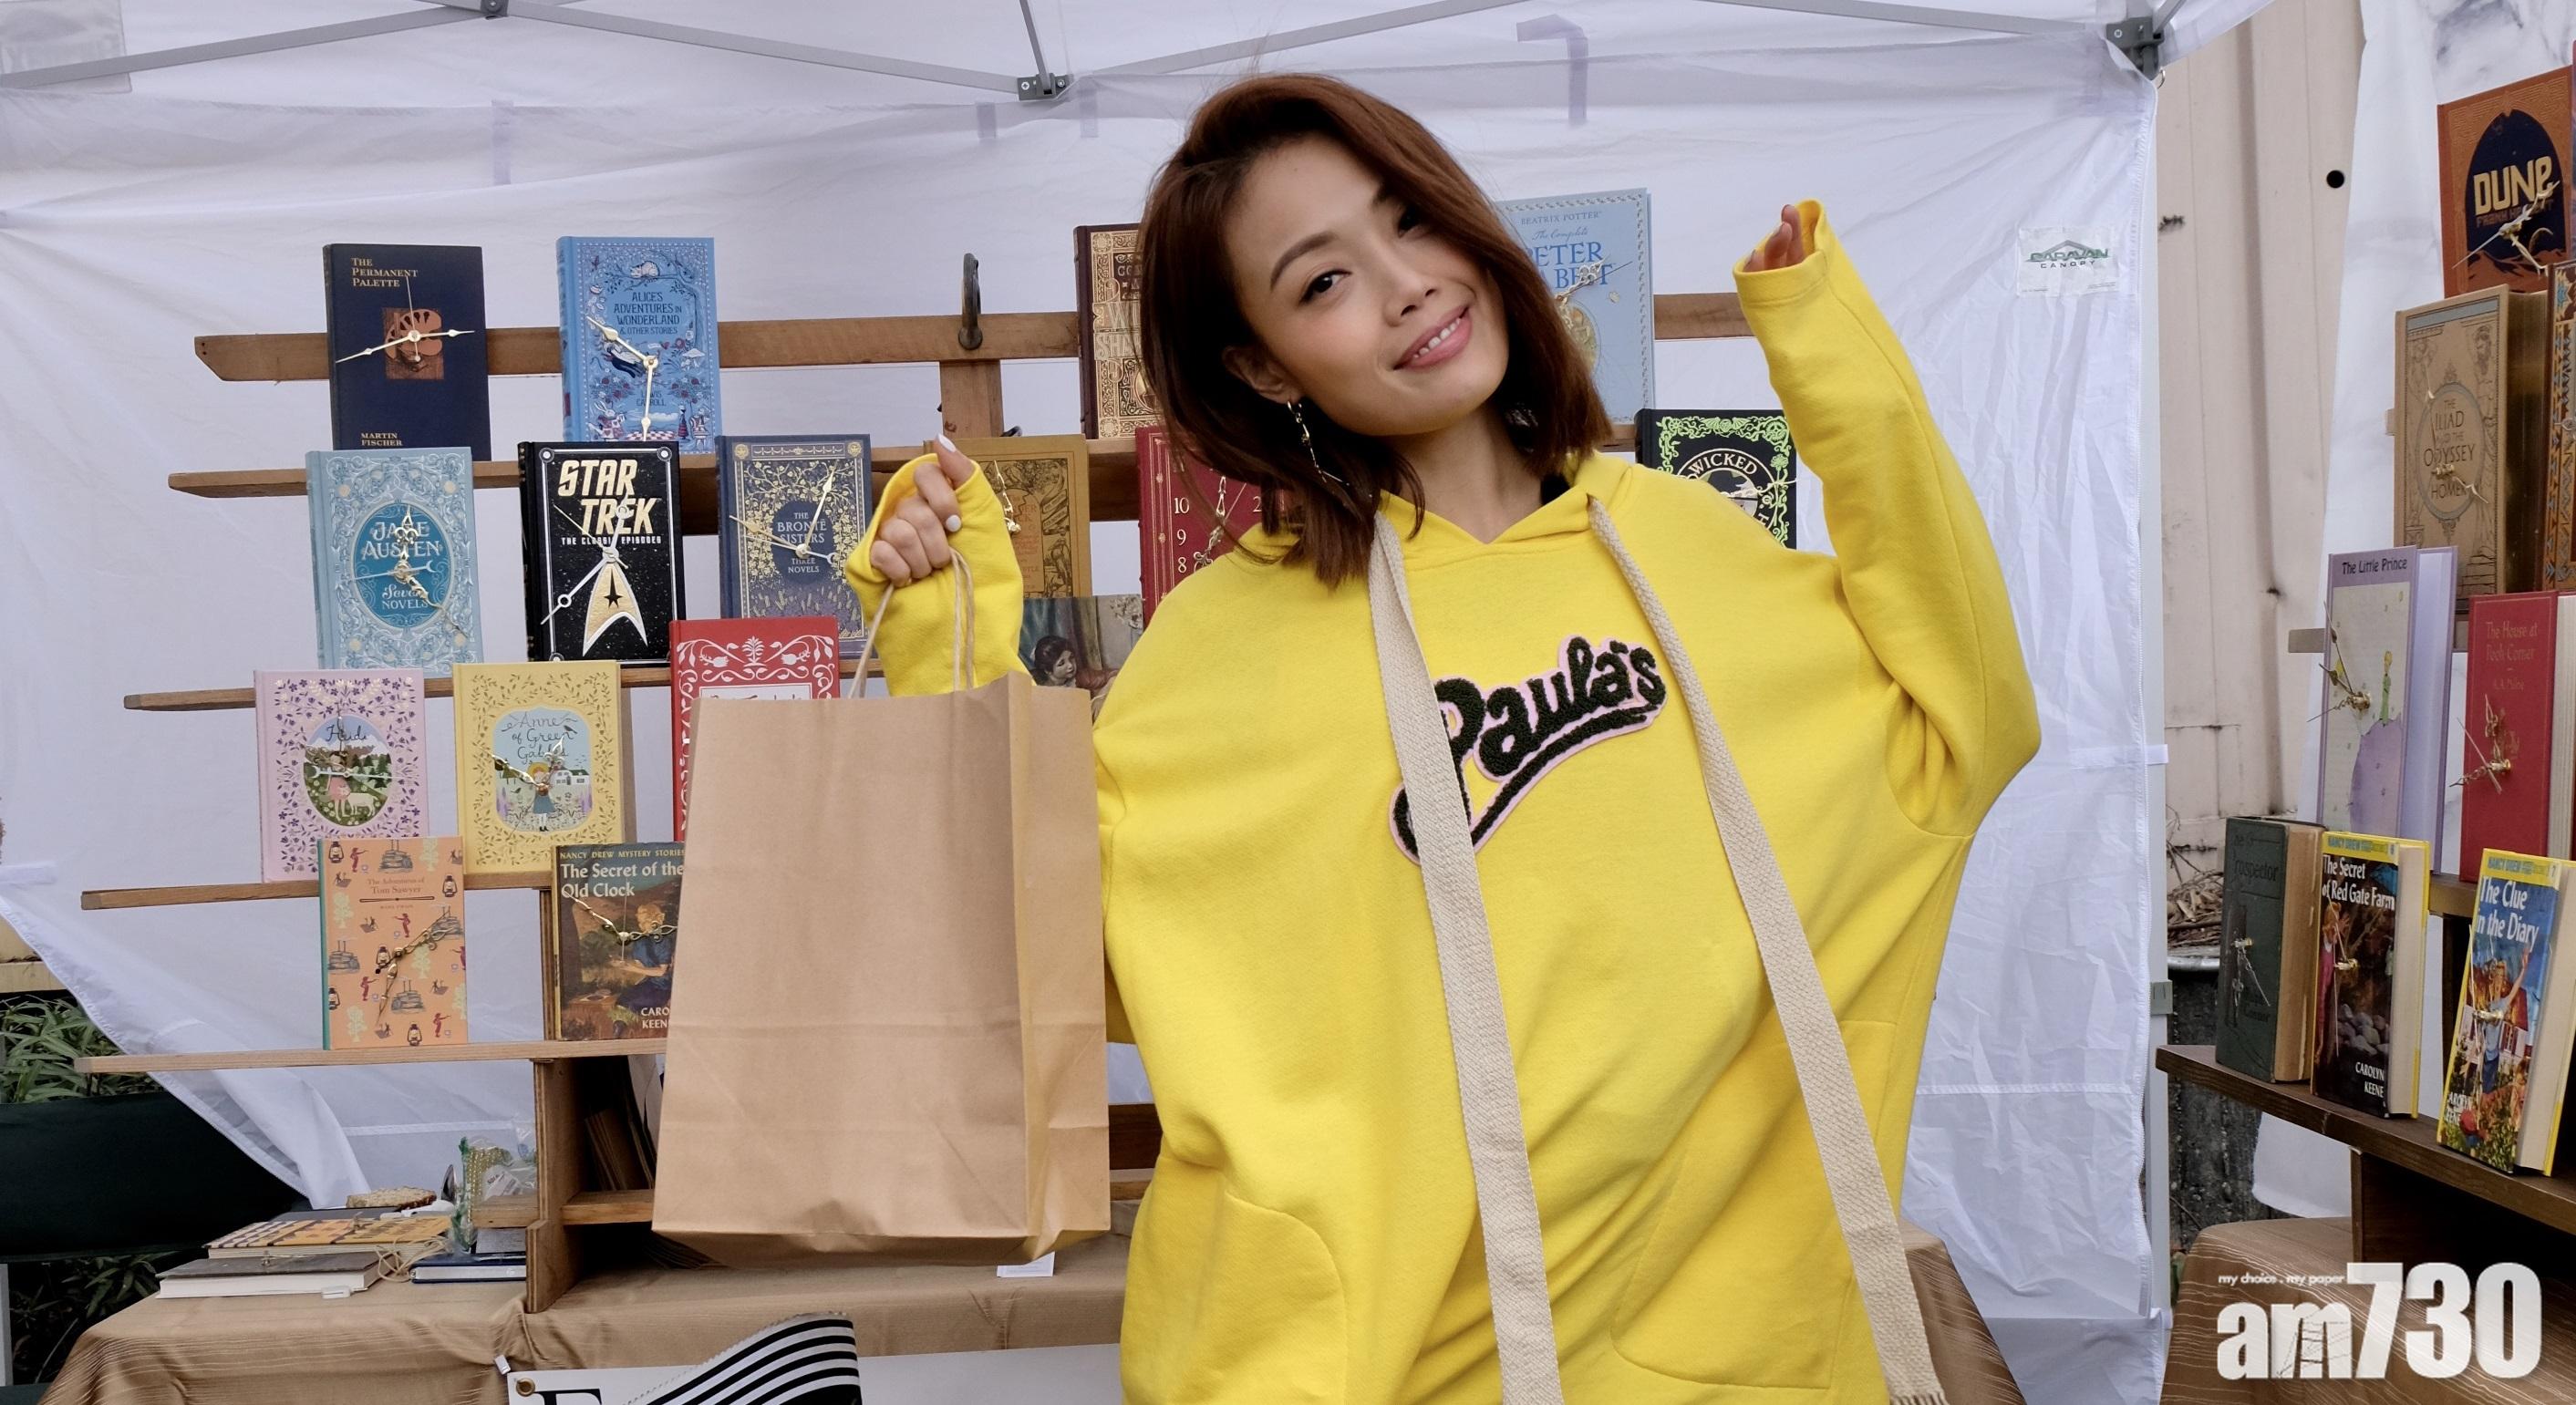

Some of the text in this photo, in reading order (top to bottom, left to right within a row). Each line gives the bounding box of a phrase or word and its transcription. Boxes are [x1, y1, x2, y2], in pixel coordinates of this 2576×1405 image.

[1521, 211, 1598, 225] BEATRIX POTTER
[351, 257, 373, 266] THE
[1527, 242, 1603, 267] ETER
[352, 267, 419, 277] PERMANENT
[2040, 260, 2095, 269] CANOPY
[353, 277, 400, 287] PALETTE
[614, 303, 682, 314] ADVENTURES IN
[616, 315, 680, 325] WONDERLAND
[626, 326, 649, 335] OTHER
[651, 326, 678, 335] STORIES
[2424, 443, 2477, 467] ODYSSEY
[1688, 453, 1758, 479] WICKED
[557, 460, 638, 497] STAR
[1174, 497, 1190, 514] 10
[580, 498, 657, 534] TREK
[370, 522, 429, 541] JAE
[1176, 529, 1186, 546] 9
[362, 541, 440, 560] AUSEN
[1177, 557, 1187, 573] 8
[2342, 562, 2356, 574] The
[2382, 557, 2407, 572] Prince
[383, 599, 428, 609] NOVELS
[526, 728, 574, 749] Green
[517, 743, 569, 764] Gabls
[591, 850, 615, 858] DREW
[618, 850, 650, 858] MYSTERY
[560, 860, 684, 878] The Secret of the
[2323, 854, 2365, 880] The Secret
[561, 882, 636, 898] Old Clock
[2332, 880, 2348, 902] Red
[2349, 883, 2370, 905] Gate
[2372, 886, 2395, 911] Farm
[2480, 876, 2528, 910] The Clue
[2487, 909, 2506, 938] the
[2507, 913, 2540, 953] Diary
[641, 1007, 670, 1017] CARO
[642, 1019, 667, 1028] KEEN
[2355, 1061, 2385, 1081] CAROLYN
[2364, 1080, 2385, 1098] KEENE
